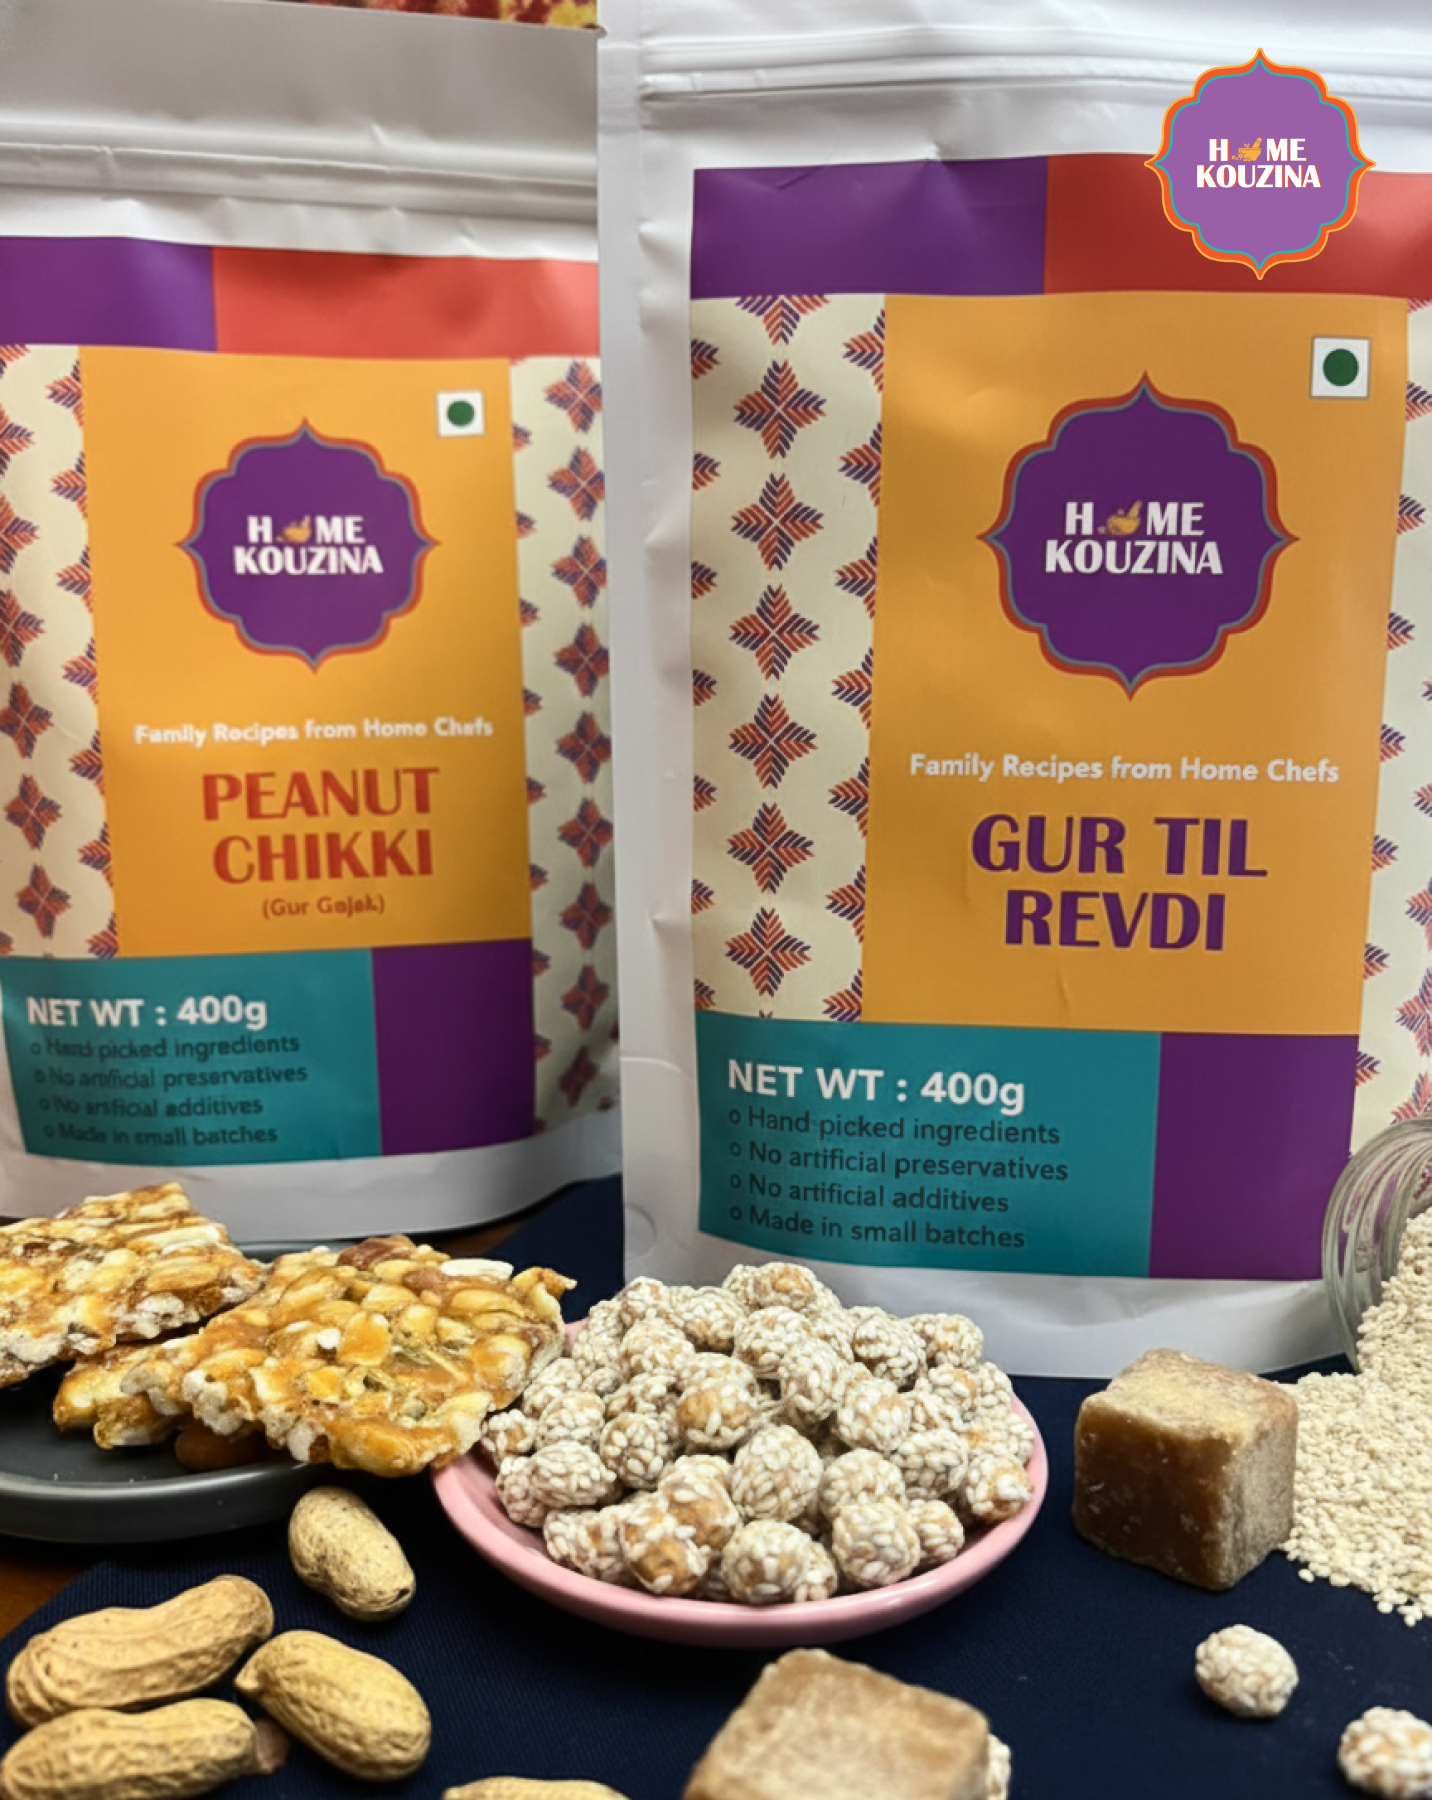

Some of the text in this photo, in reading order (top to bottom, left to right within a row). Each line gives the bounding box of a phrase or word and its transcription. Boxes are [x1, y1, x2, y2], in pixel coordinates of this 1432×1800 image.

[247, 514, 366, 544] HME
[1065, 501, 1205, 536] HME
[233, 545, 384, 575] KOUZINA
[1045, 539, 1224, 574] KOUZINA
[134, 716, 494, 748] Family Recipes from Home Chefs
[910, 753, 1339, 783] Family Recipes from Home Chefs
[202, 767, 440, 821] PEANUT
[213, 829, 433, 885] CHIKKI
[972, 814, 1268, 877] GUR TIL
[262, 897, 310, 920] (Gur
[1005, 889, 1225, 951] REVDI
[27, 994, 268, 1031] NET WT : 400g
[99, 1037, 167, 1063] picked
[174, 1034, 300, 1062] ingredients
[163, 1064, 308, 1091] preservatives
[728, 1058, 1025, 1116] NET WT : 400g
[165, 1097, 263, 1118] additives
[113, 1126, 129, 1145] in
[134, 1126, 187, 1146] small
[193, 1125, 278, 1146] batches
[749, 1105, 1060, 1147] Hand picked ingredients
[750, 1141, 1068, 1181] No artificial preservatives
[750, 1173, 1009, 1212] No artificial additives
[750, 1205, 1025, 1248] Made in small batches
